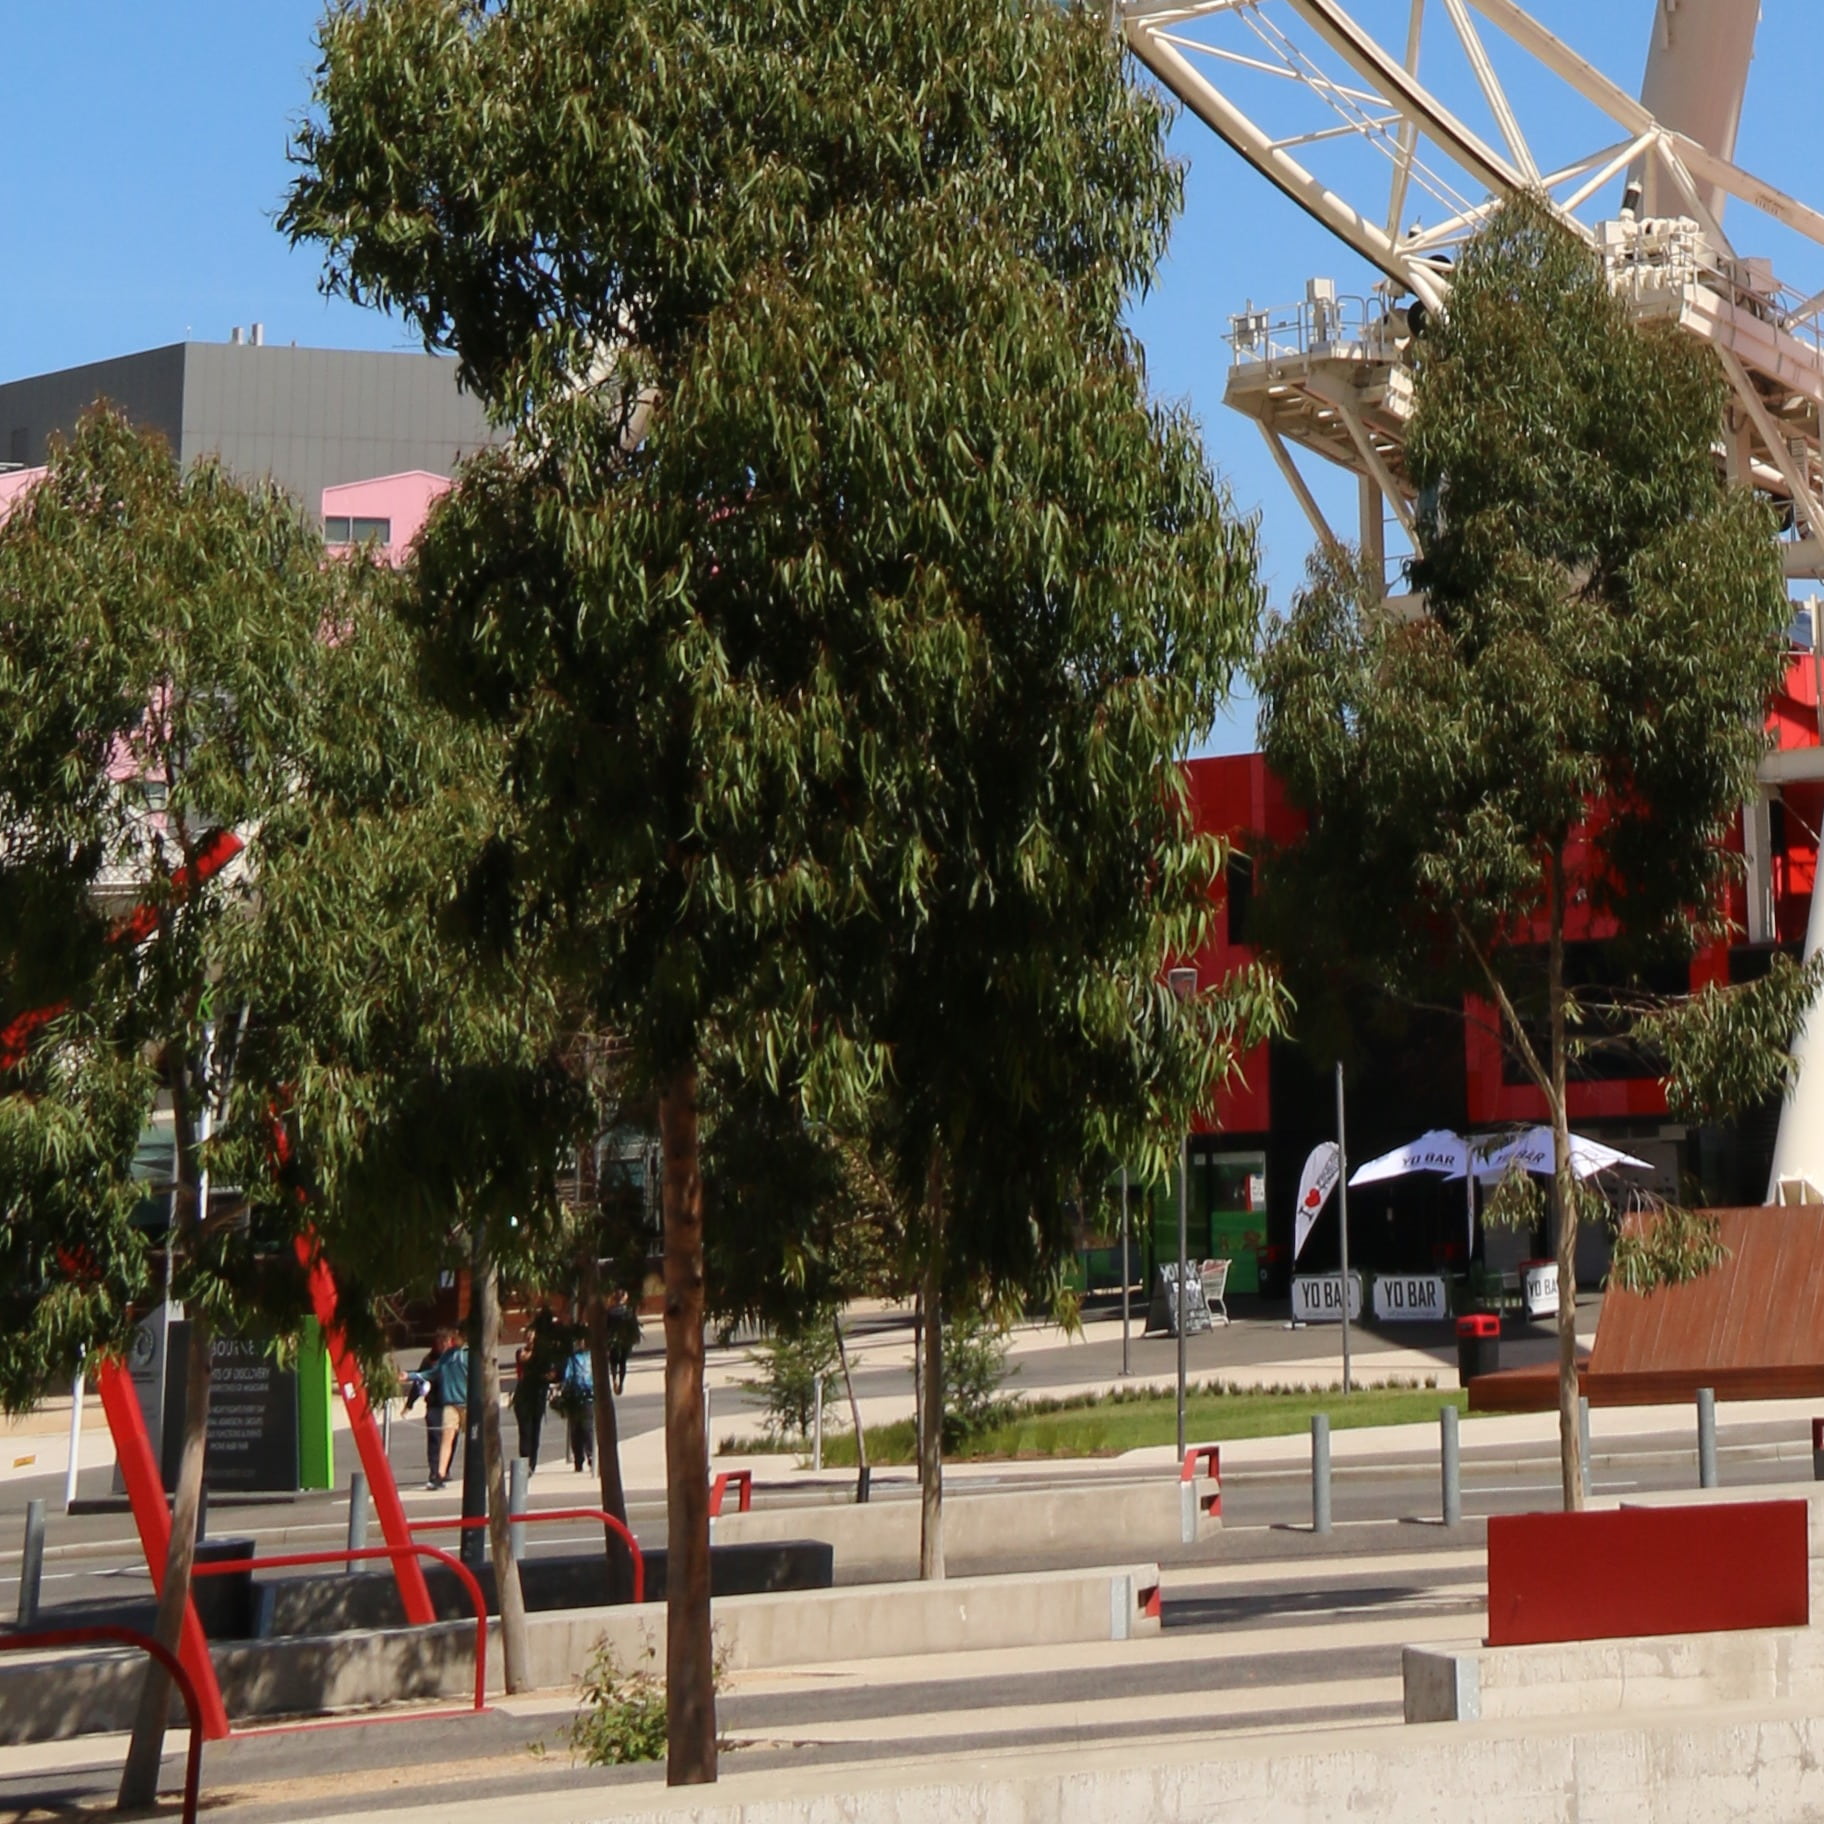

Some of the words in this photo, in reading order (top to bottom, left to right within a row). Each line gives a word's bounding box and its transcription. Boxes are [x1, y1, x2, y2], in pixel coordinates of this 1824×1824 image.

[1425, 1153, 1455, 1165] BAR
[1302, 1281, 1320, 1308] YO
[1324, 1281, 1351, 1308] BA
[1384, 1280, 1404, 1307] YO
[1408, 1280, 1436, 1307] BAR
[1528, 1279, 1542, 1297] YO
[1544, 1278, 1557, 1295] BA
